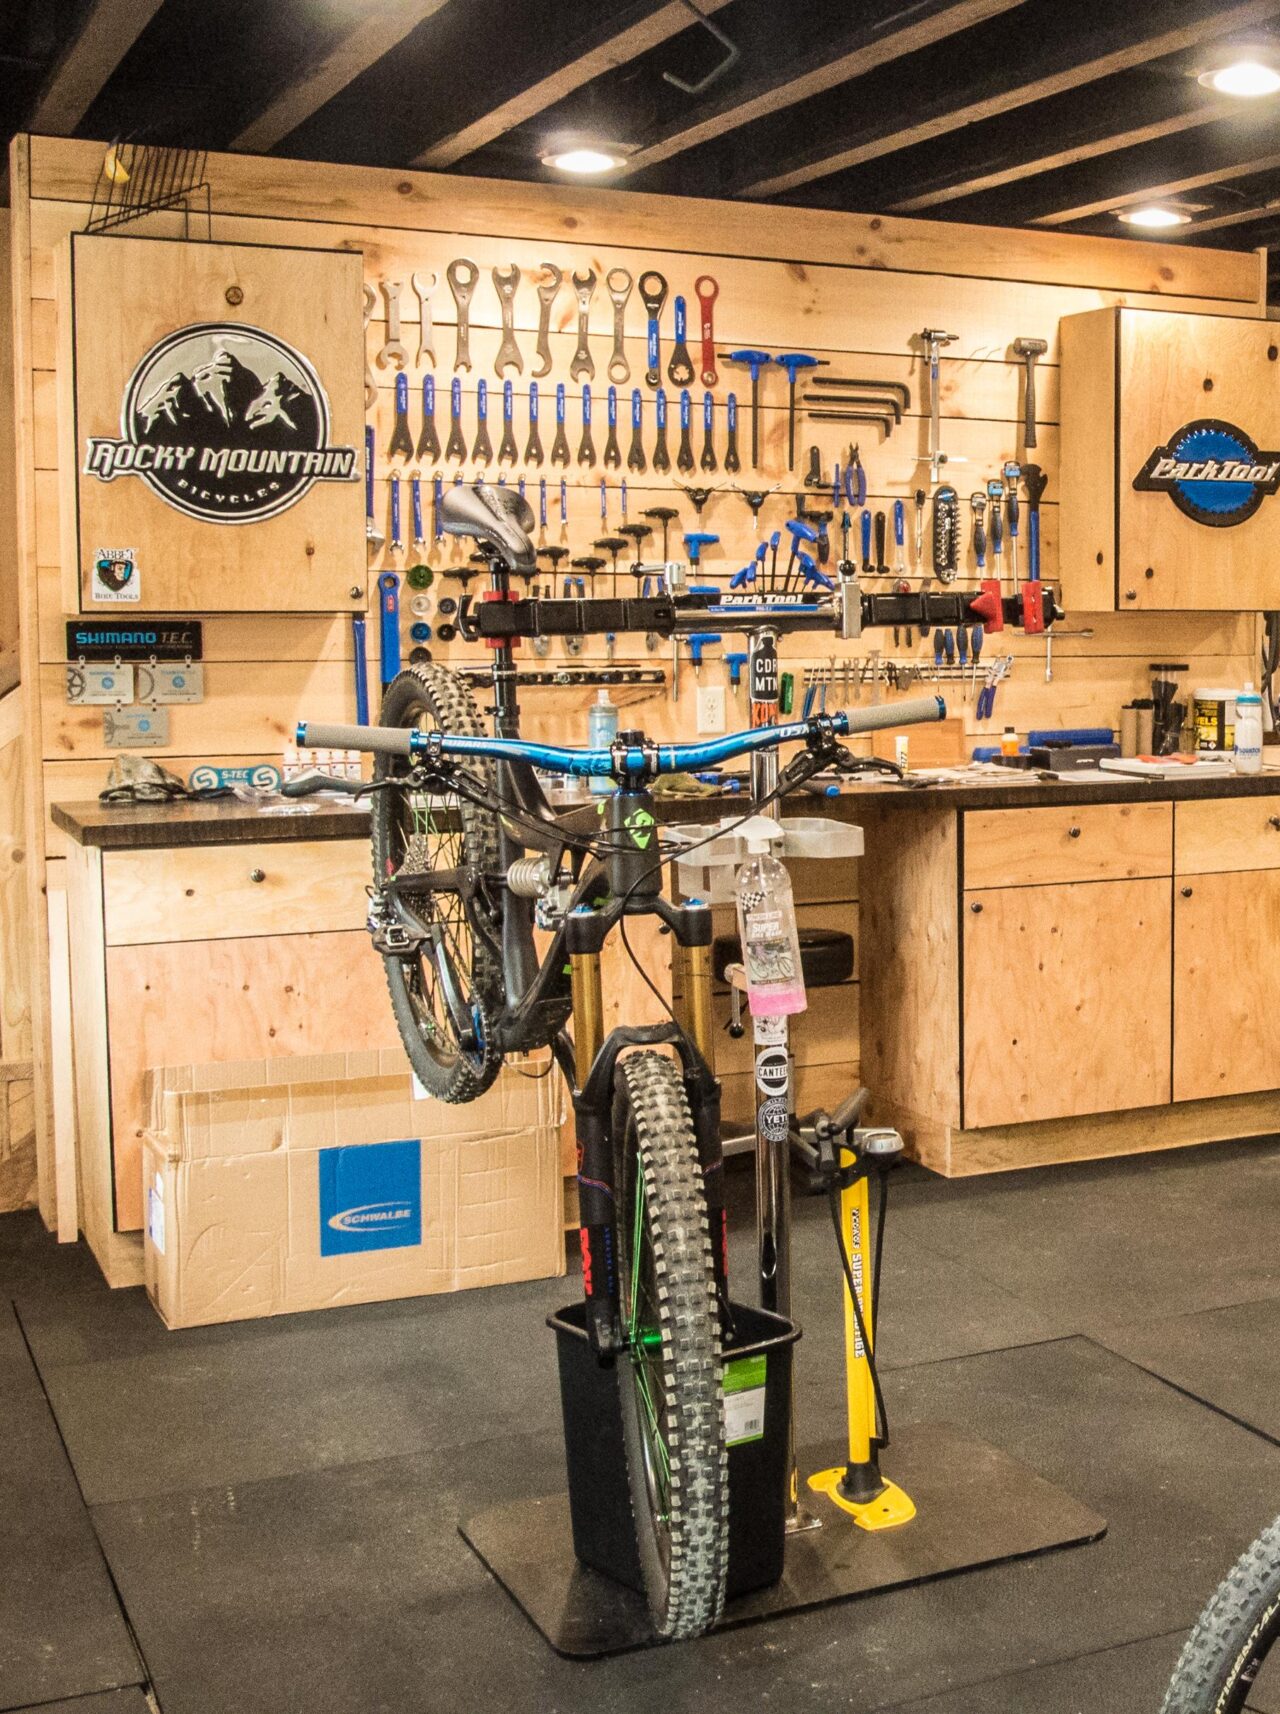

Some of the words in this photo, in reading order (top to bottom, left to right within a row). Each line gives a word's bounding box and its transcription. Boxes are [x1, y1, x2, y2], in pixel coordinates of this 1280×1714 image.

[93, 443, 195, 476] ROCKY
[199, 446, 353, 479] MOUNTAIN
[177, 478, 281, 504] BICYCLES
[75, 631, 157, 645] SHIMANO
[751, 702, 779, 729] KON
[221, 769, 250, 779] S-TEC
[765, 1113, 787, 1124] YET
[342, 1207, 413, 1226] SCHWALBE
[851, 1253, 864, 1297] SUPER
